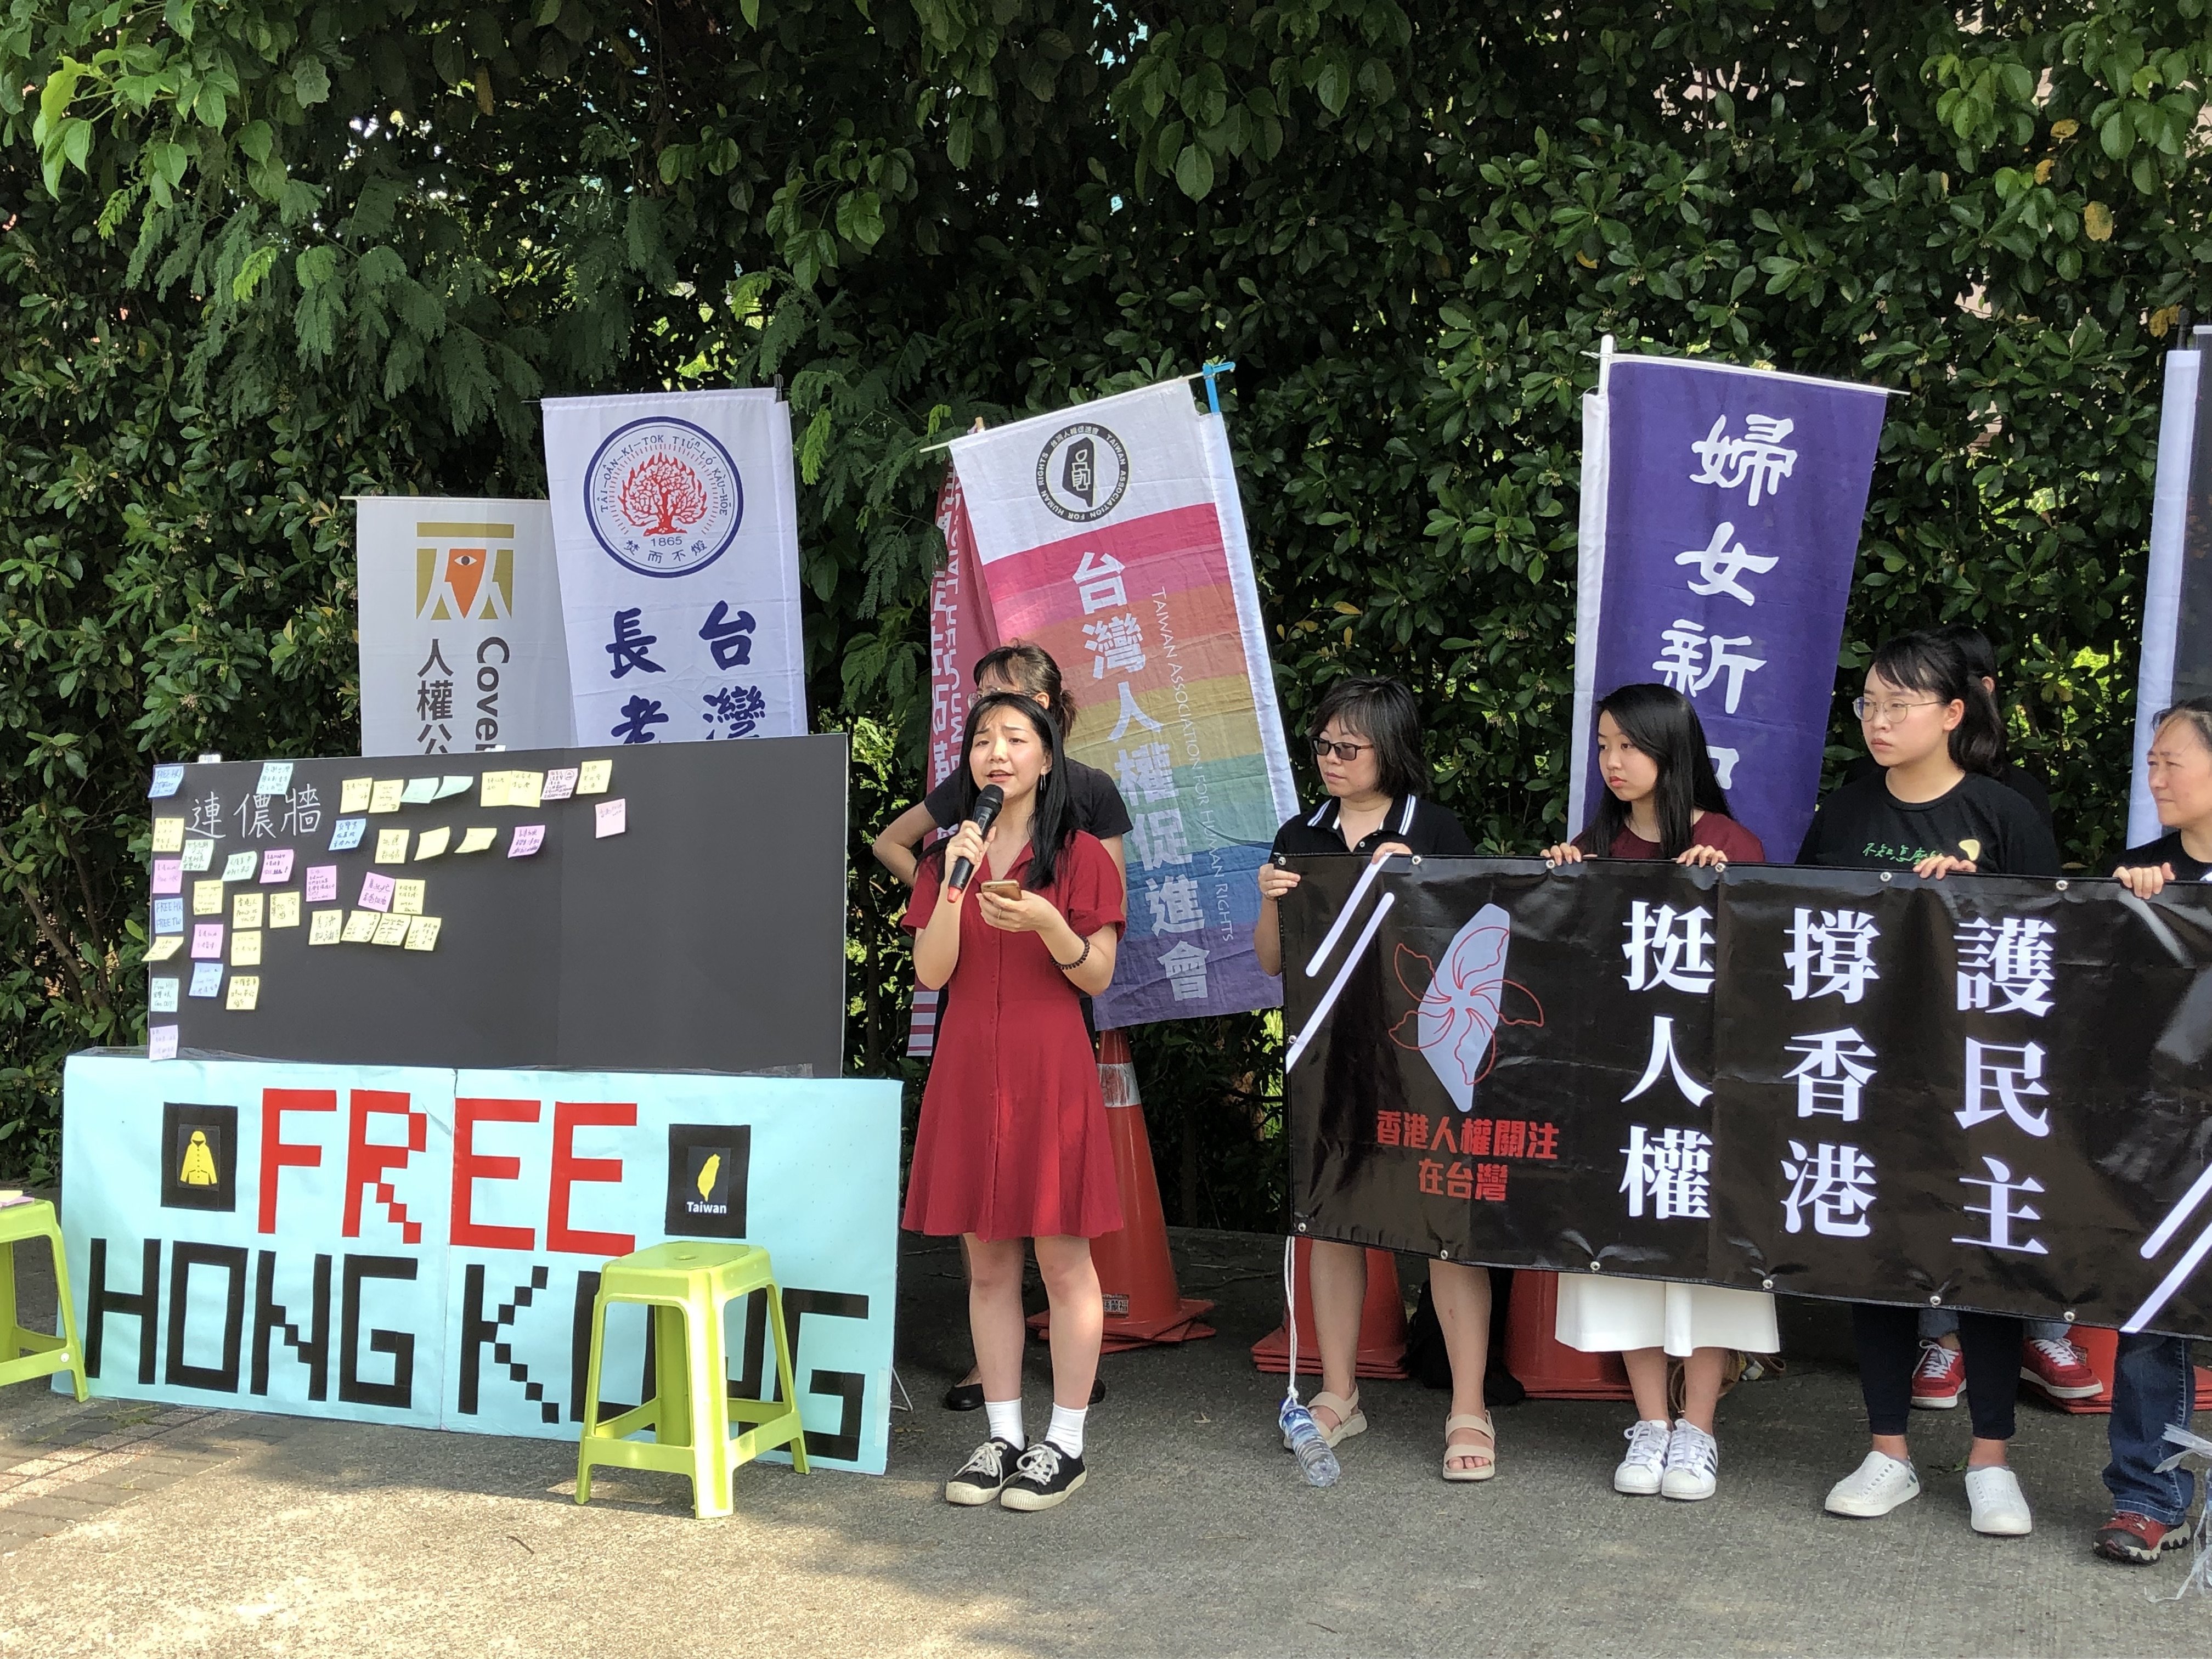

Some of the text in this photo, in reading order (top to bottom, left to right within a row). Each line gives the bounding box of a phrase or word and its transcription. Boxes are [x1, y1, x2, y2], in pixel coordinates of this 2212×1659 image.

[1037, 434, 1126, 520] TAIWAN ASSOCIATION FOR HUMAN RIGHTS
[650, 536, 683, 547] 1865
[1652, 414, 1797, 790] 婦女新
[416, 638, 454, 755] 人權公
[475, 636, 510, 752] Cove
[698, 600, 766, 740] 台灣
[184, 783, 321, 838] 連儂牆
[1071, 551, 1210, 1002] 台灣人權促進會
[1151, 585, 1234, 942] TAIWAN ASSOCIATION FOR HUMAN RIGHTS
[156, 902, 172, 913] FREE
[156, 918, 171, 928] FREE
[1618, 900, 1716, 1220] 挺人權
[1780, 907, 1881, 1237] 撐香港
[1951, 917, 2057, 1255] 護民主
[257, 1088, 637, 1257] FREE
[1376, 1109, 1559, 1160] 香港人權關注
[1418, 1158, 1509, 1202] 在台灣
[686, 1201, 727, 1214] Taiwan
[84, 1237, 418, 1409] HONG
